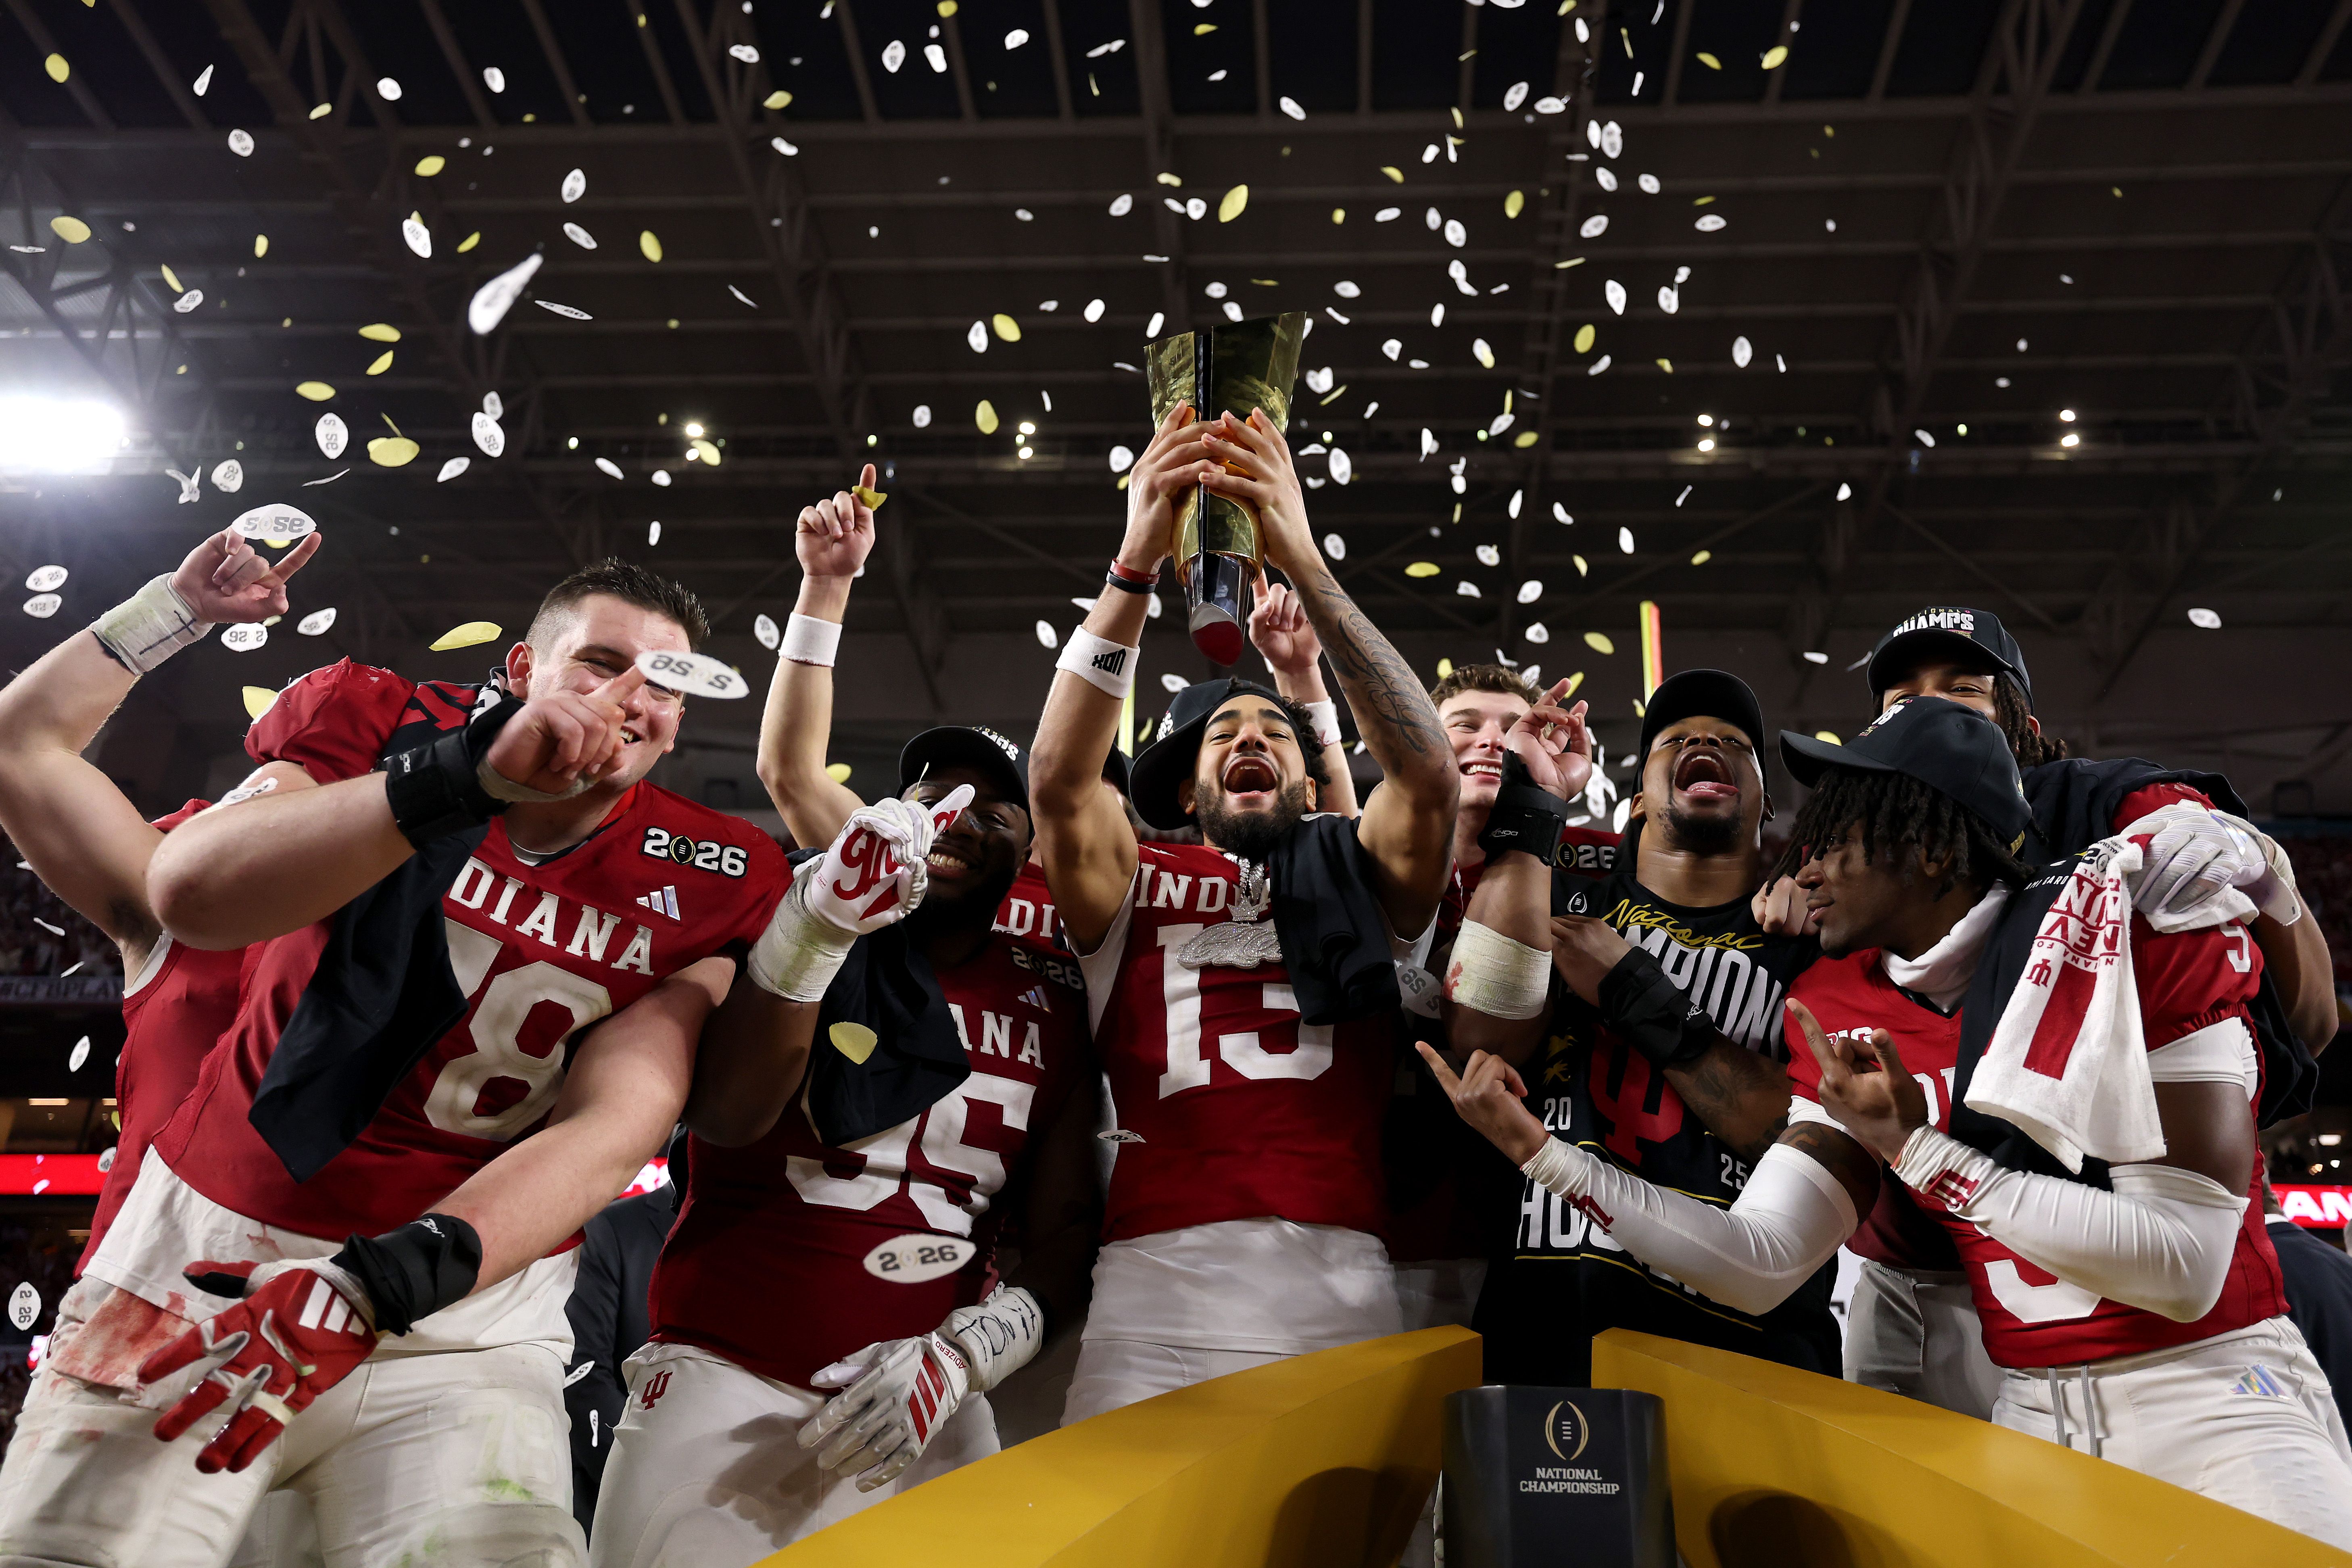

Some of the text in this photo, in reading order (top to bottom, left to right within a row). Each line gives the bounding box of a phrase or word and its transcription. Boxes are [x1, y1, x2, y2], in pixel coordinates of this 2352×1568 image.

[642, 827, 748, 878] 2026
[1553, 843, 1616, 869] 026
[1011, 946, 1084, 990] 2026
[1611, 925, 1785, 1063] MPION
[1544, 1096, 1571, 1131] 20
[879, 1245, 959, 1272] 2026
[935, 1341, 967, 1369] ADIZERO
[1536, 1467, 1603, 1480] NATIONAL
[1519, 1481, 1620, 1495] CHAMPIONSHIP
